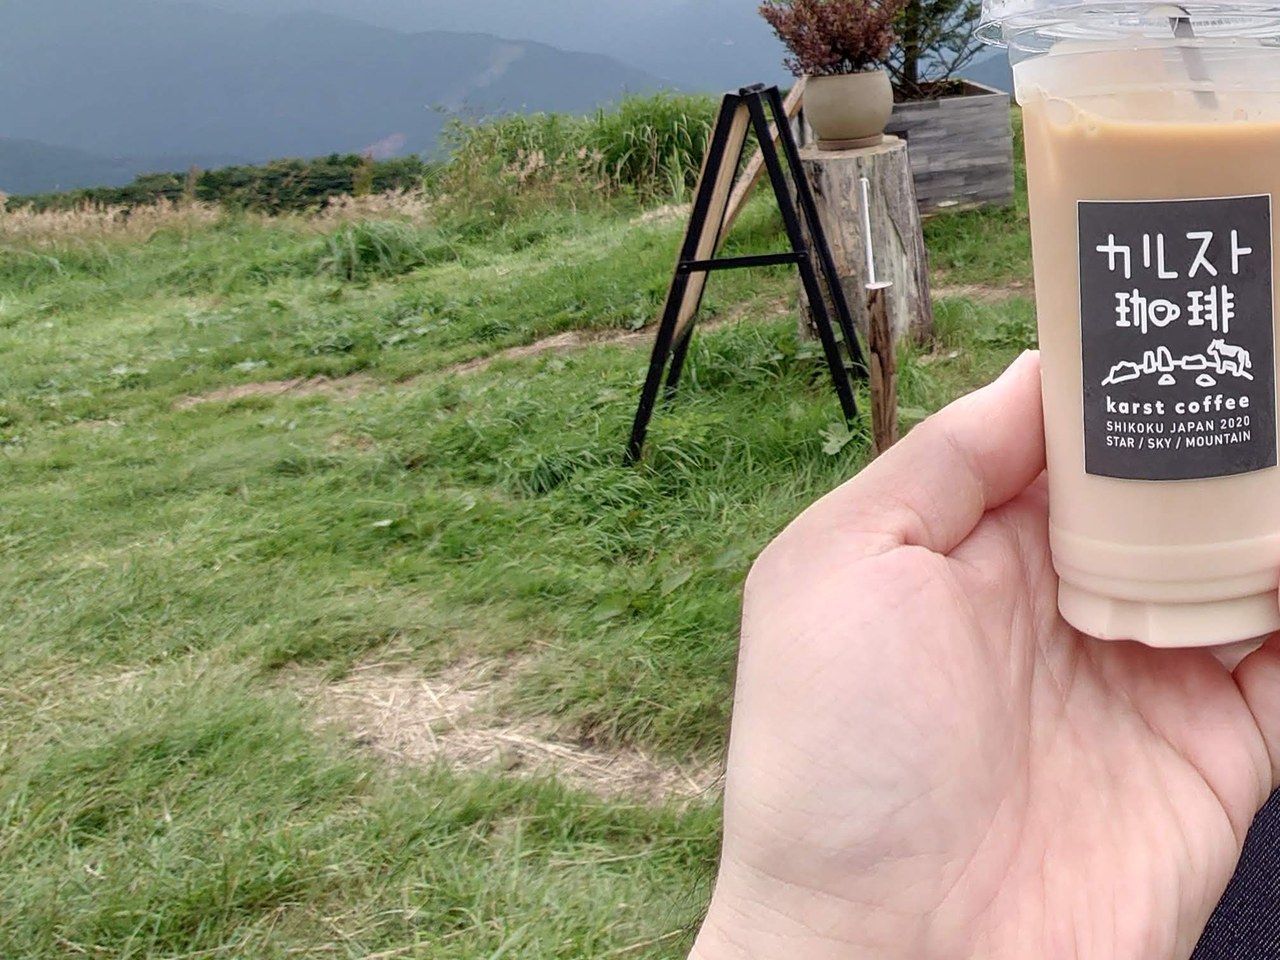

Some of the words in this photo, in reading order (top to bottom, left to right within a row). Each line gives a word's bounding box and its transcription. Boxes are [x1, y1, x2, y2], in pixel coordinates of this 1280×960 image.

[1096, 229, 1252, 279] カルスト
[1115, 285, 1235, 334] 珈琲
[1106, 395, 1165, 415] karst
[1175, 394, 1250, 414] coffee
[1106, 421, 1164, 434] SHIKOKU
[1170, 420, 1214, 433] JAPAN
[1220, 415, 1250, 430] 2020
[1106, 436, 1135, 448] STAR
[1147, 437, 1172, 450] SKY
[1185, 430, 1251, 448] MOUNTAIN
